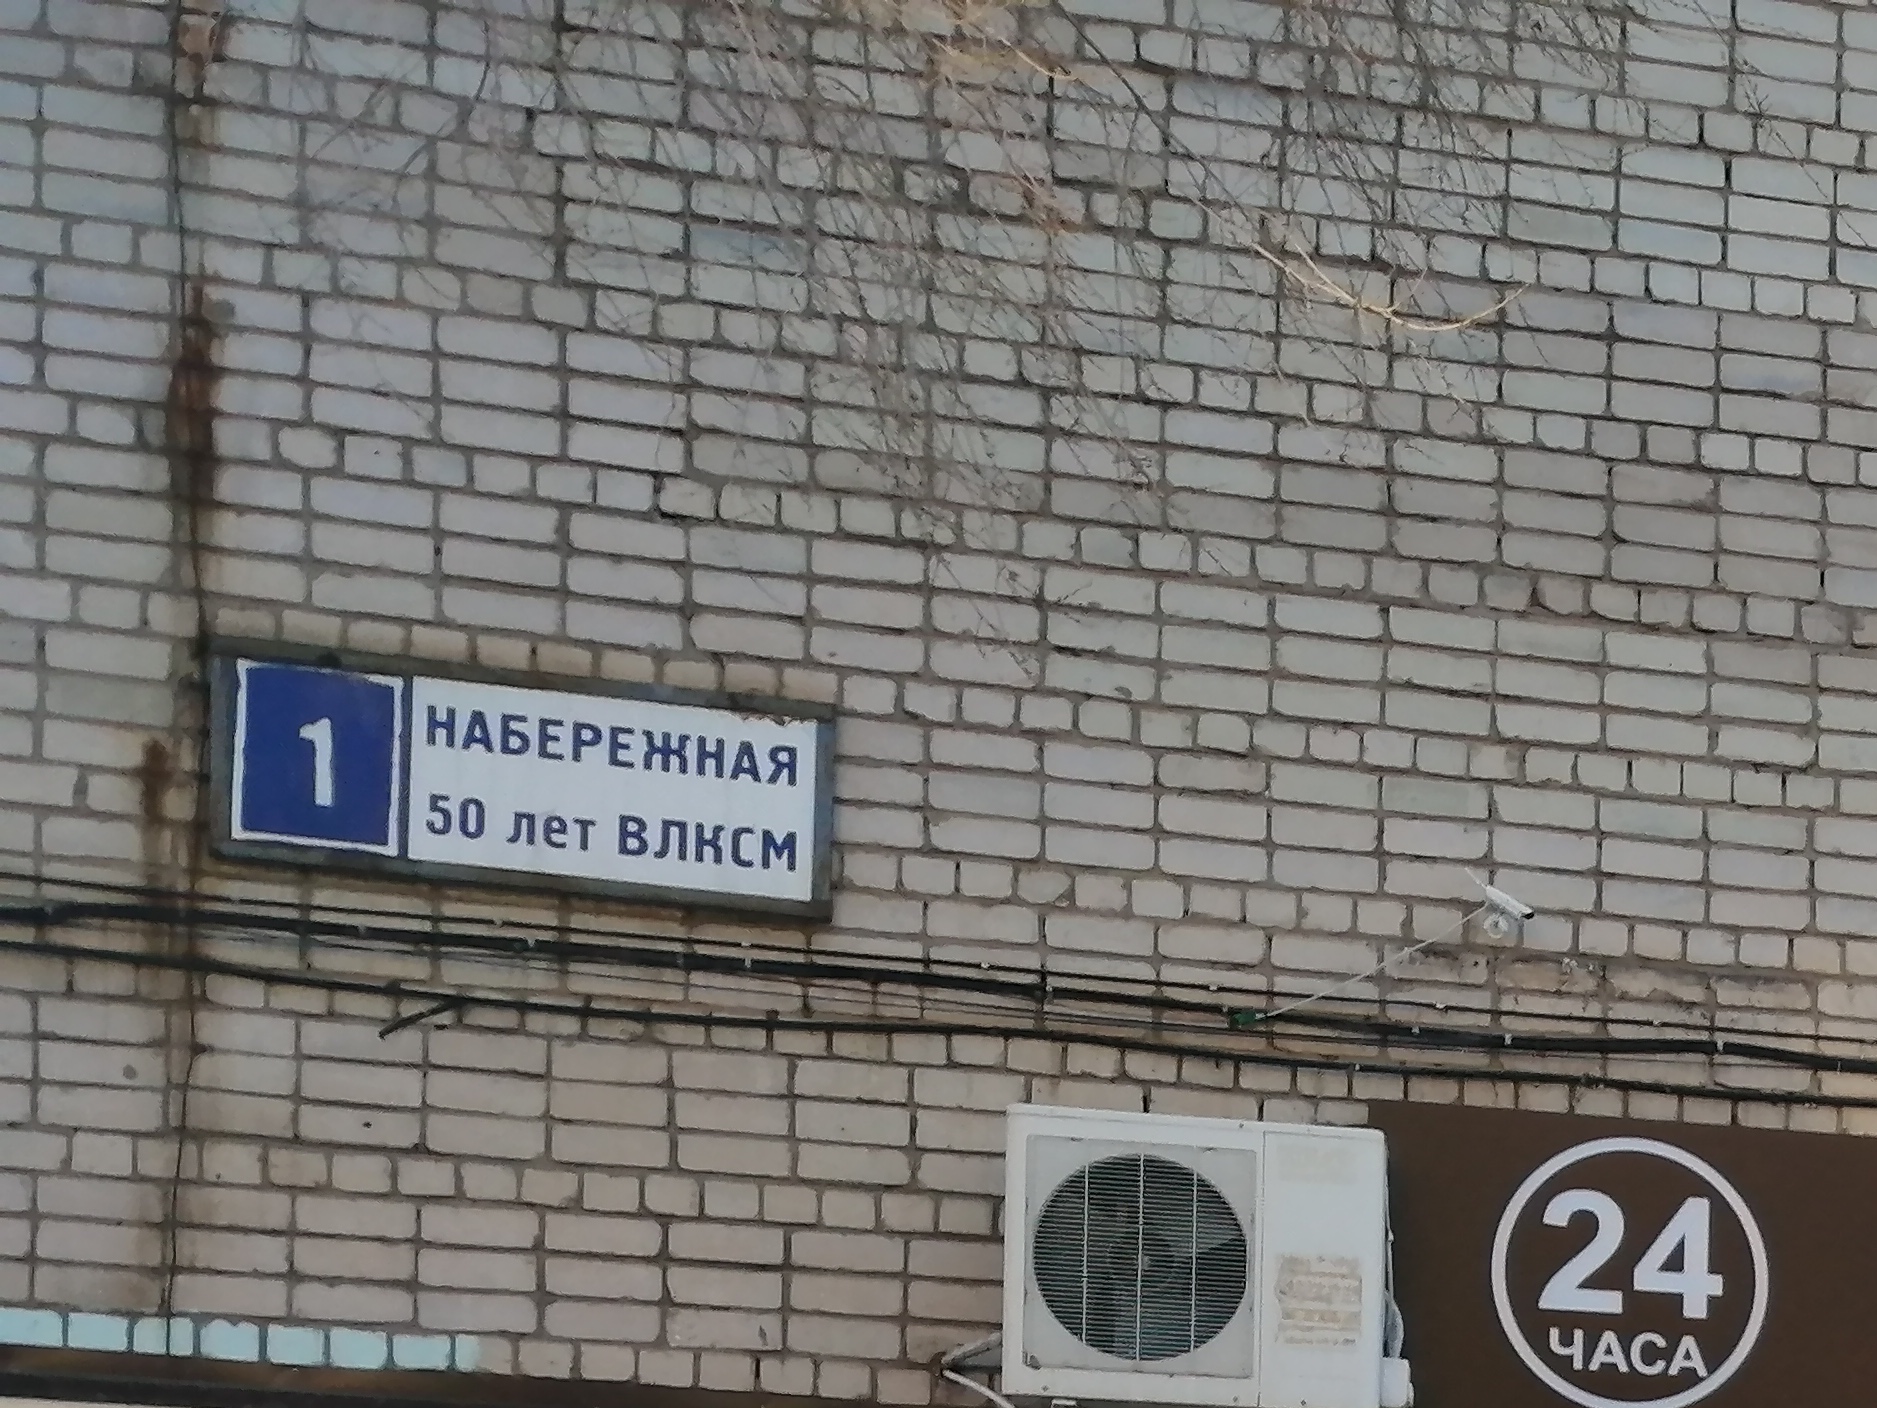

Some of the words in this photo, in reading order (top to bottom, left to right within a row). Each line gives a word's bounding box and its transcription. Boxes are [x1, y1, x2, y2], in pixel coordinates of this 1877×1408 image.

[300, 717, 334, 807] 1
[426, 705, 799, 787] НАБЕРЕЖНАЯ
[426, 794, 487, 841] 50
[506, 809, 597, 853] лет
[617, 813, 799, 873] ВЛКСМ
[1537, 1188, 1724, 1320] 24
[1547, 1327, 1710, 1379] ЧАСА
